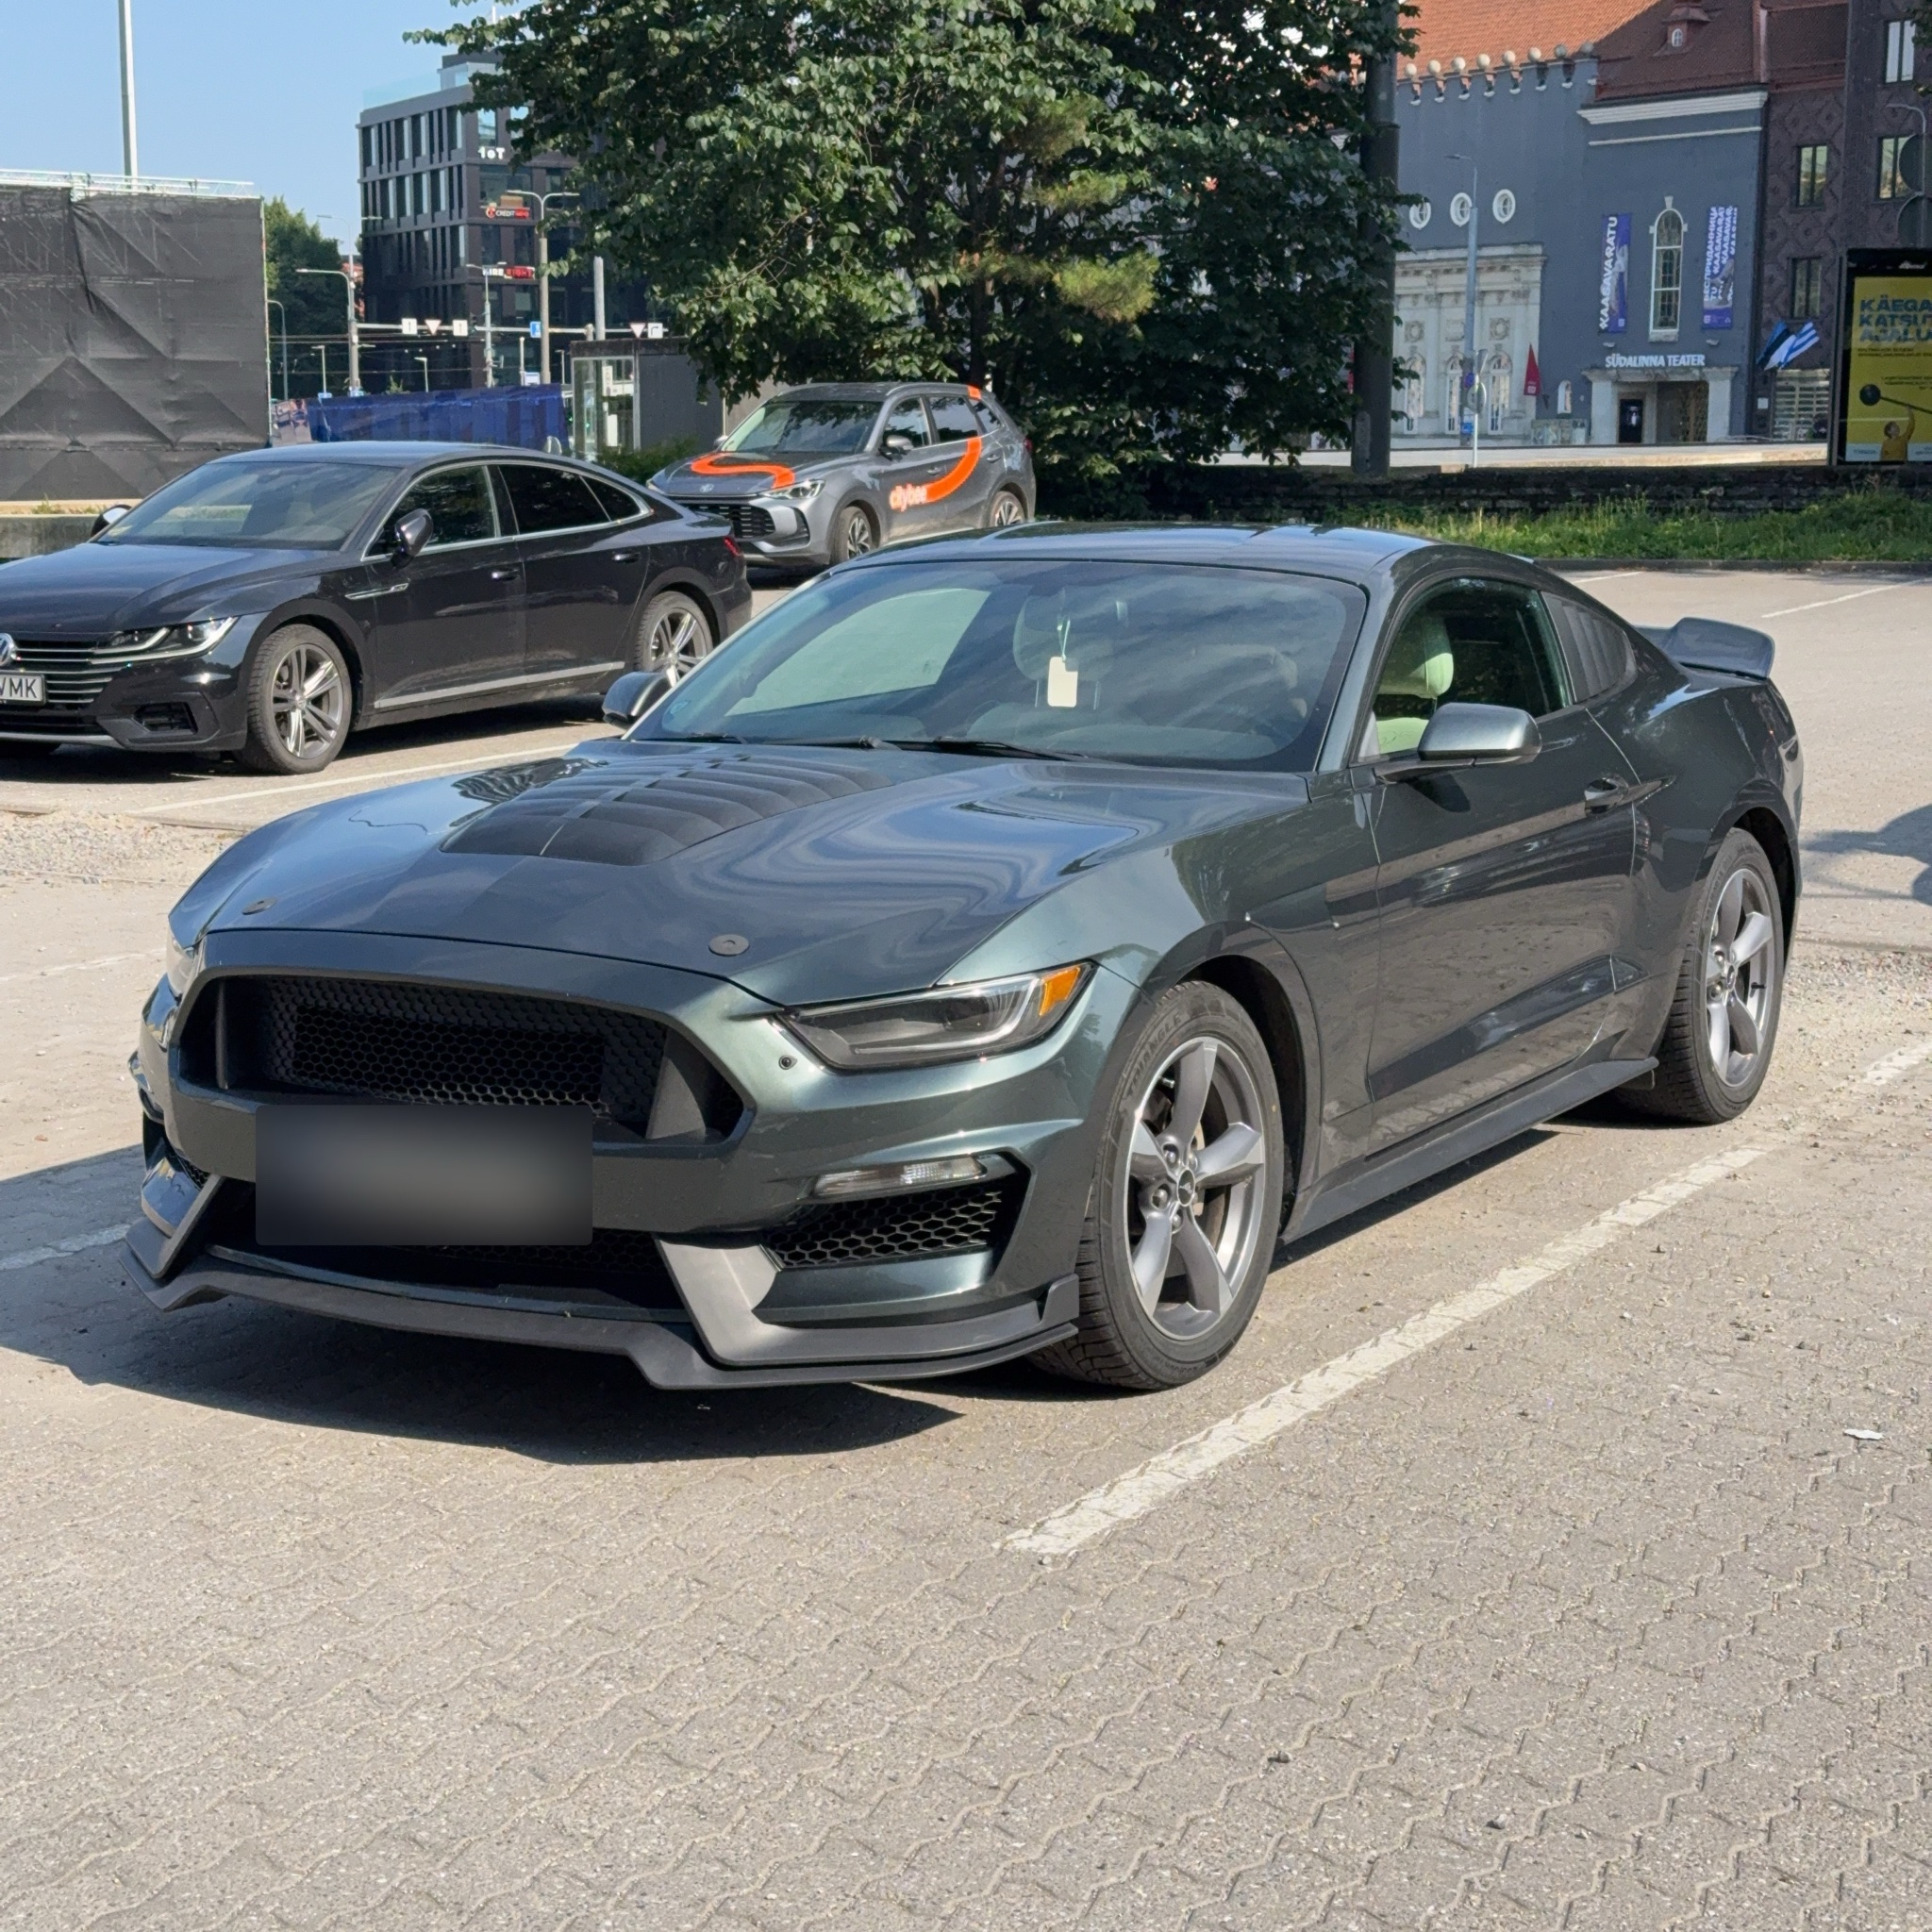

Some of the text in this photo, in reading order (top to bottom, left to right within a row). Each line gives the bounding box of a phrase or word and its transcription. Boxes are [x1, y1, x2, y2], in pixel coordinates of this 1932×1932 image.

[1599, 216, 1618, 330] KAASAVARATU
[1605, 353, 1706, 368] SÜDALINNA TEATER
[1126, 1011, 1183, 1096] TRIANGLE
